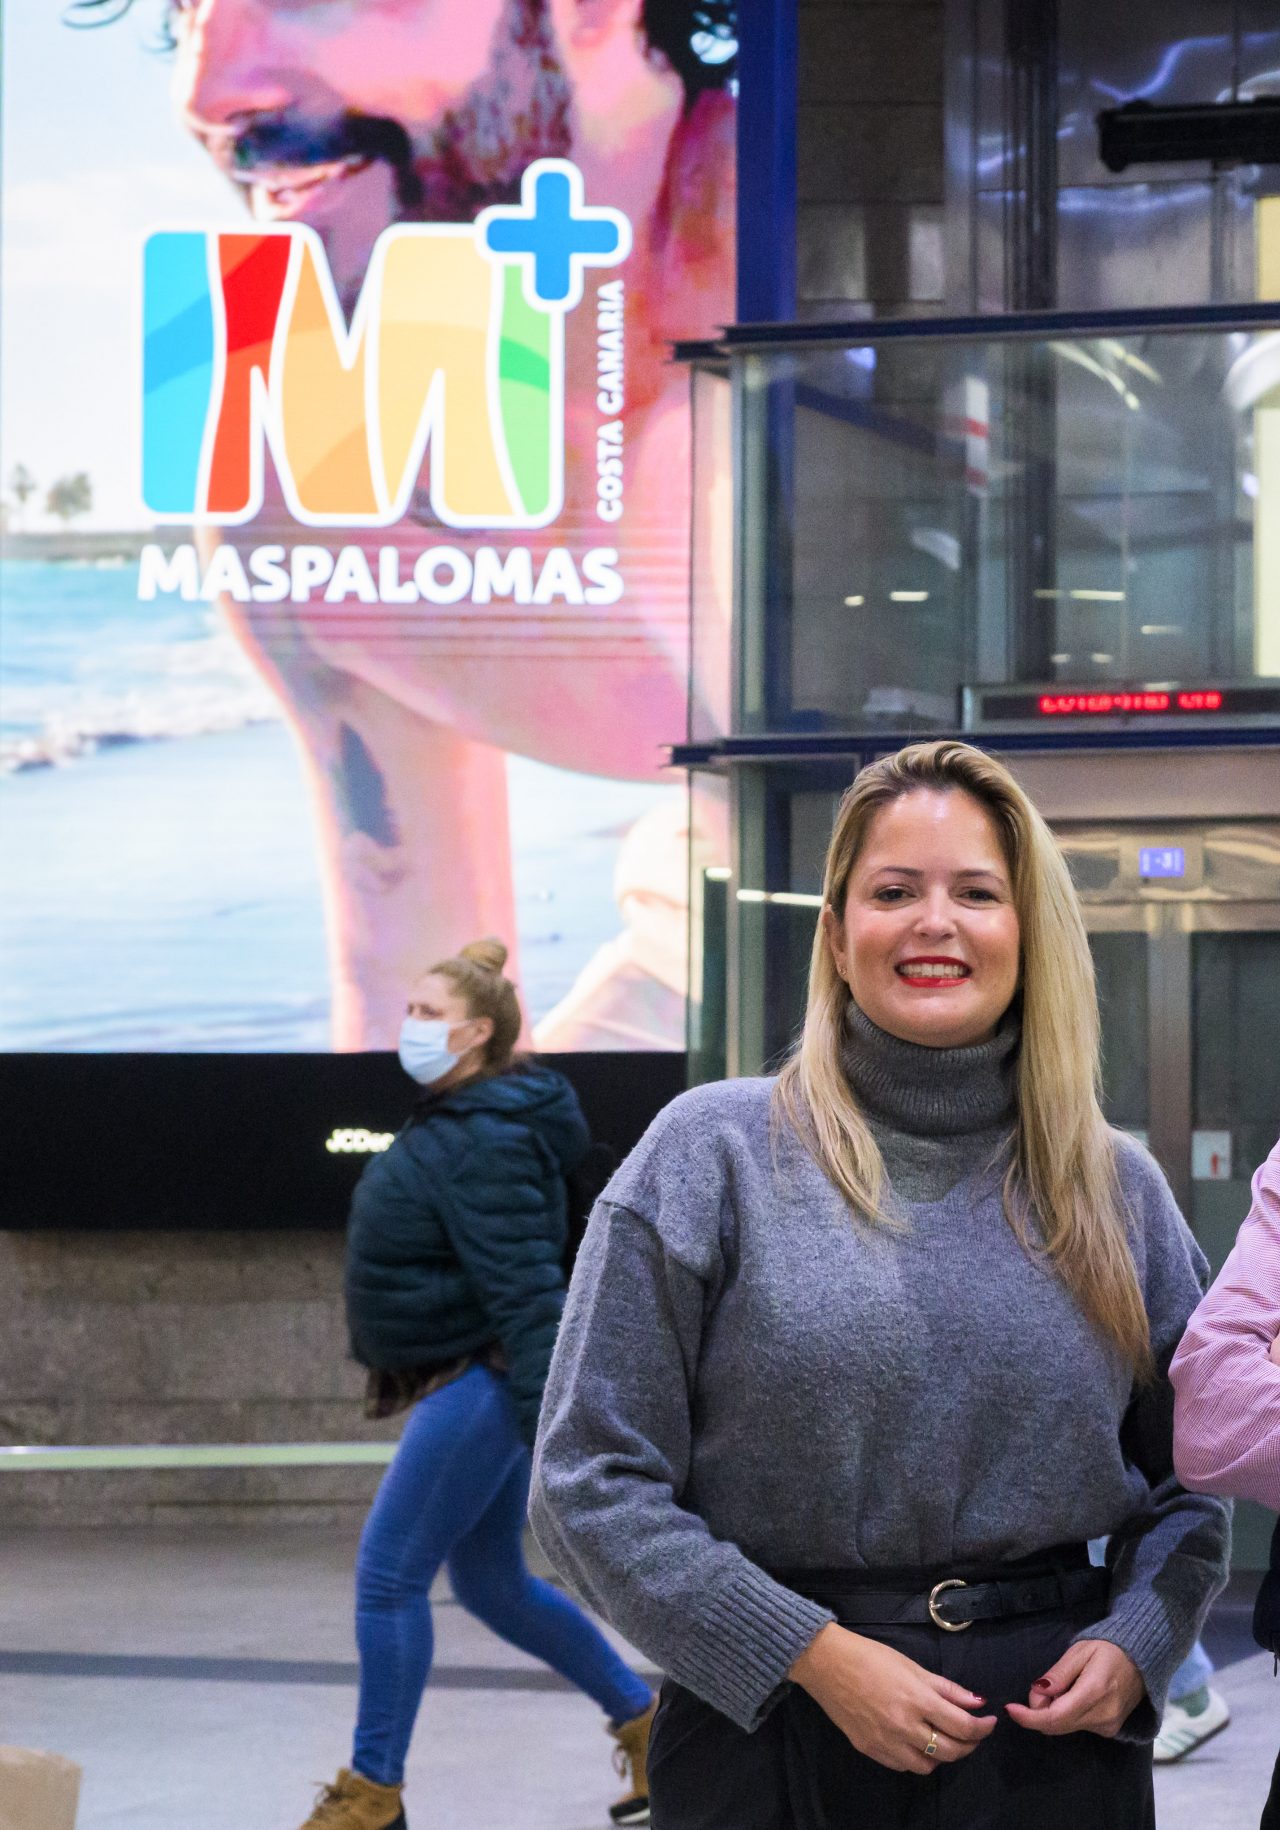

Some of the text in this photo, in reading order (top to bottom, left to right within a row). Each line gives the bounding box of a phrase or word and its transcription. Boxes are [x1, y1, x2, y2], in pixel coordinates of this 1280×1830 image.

[596, 279, 624, 522] COSTA CANARIA
[137, 544, 625, 605] MASPALOMAS
